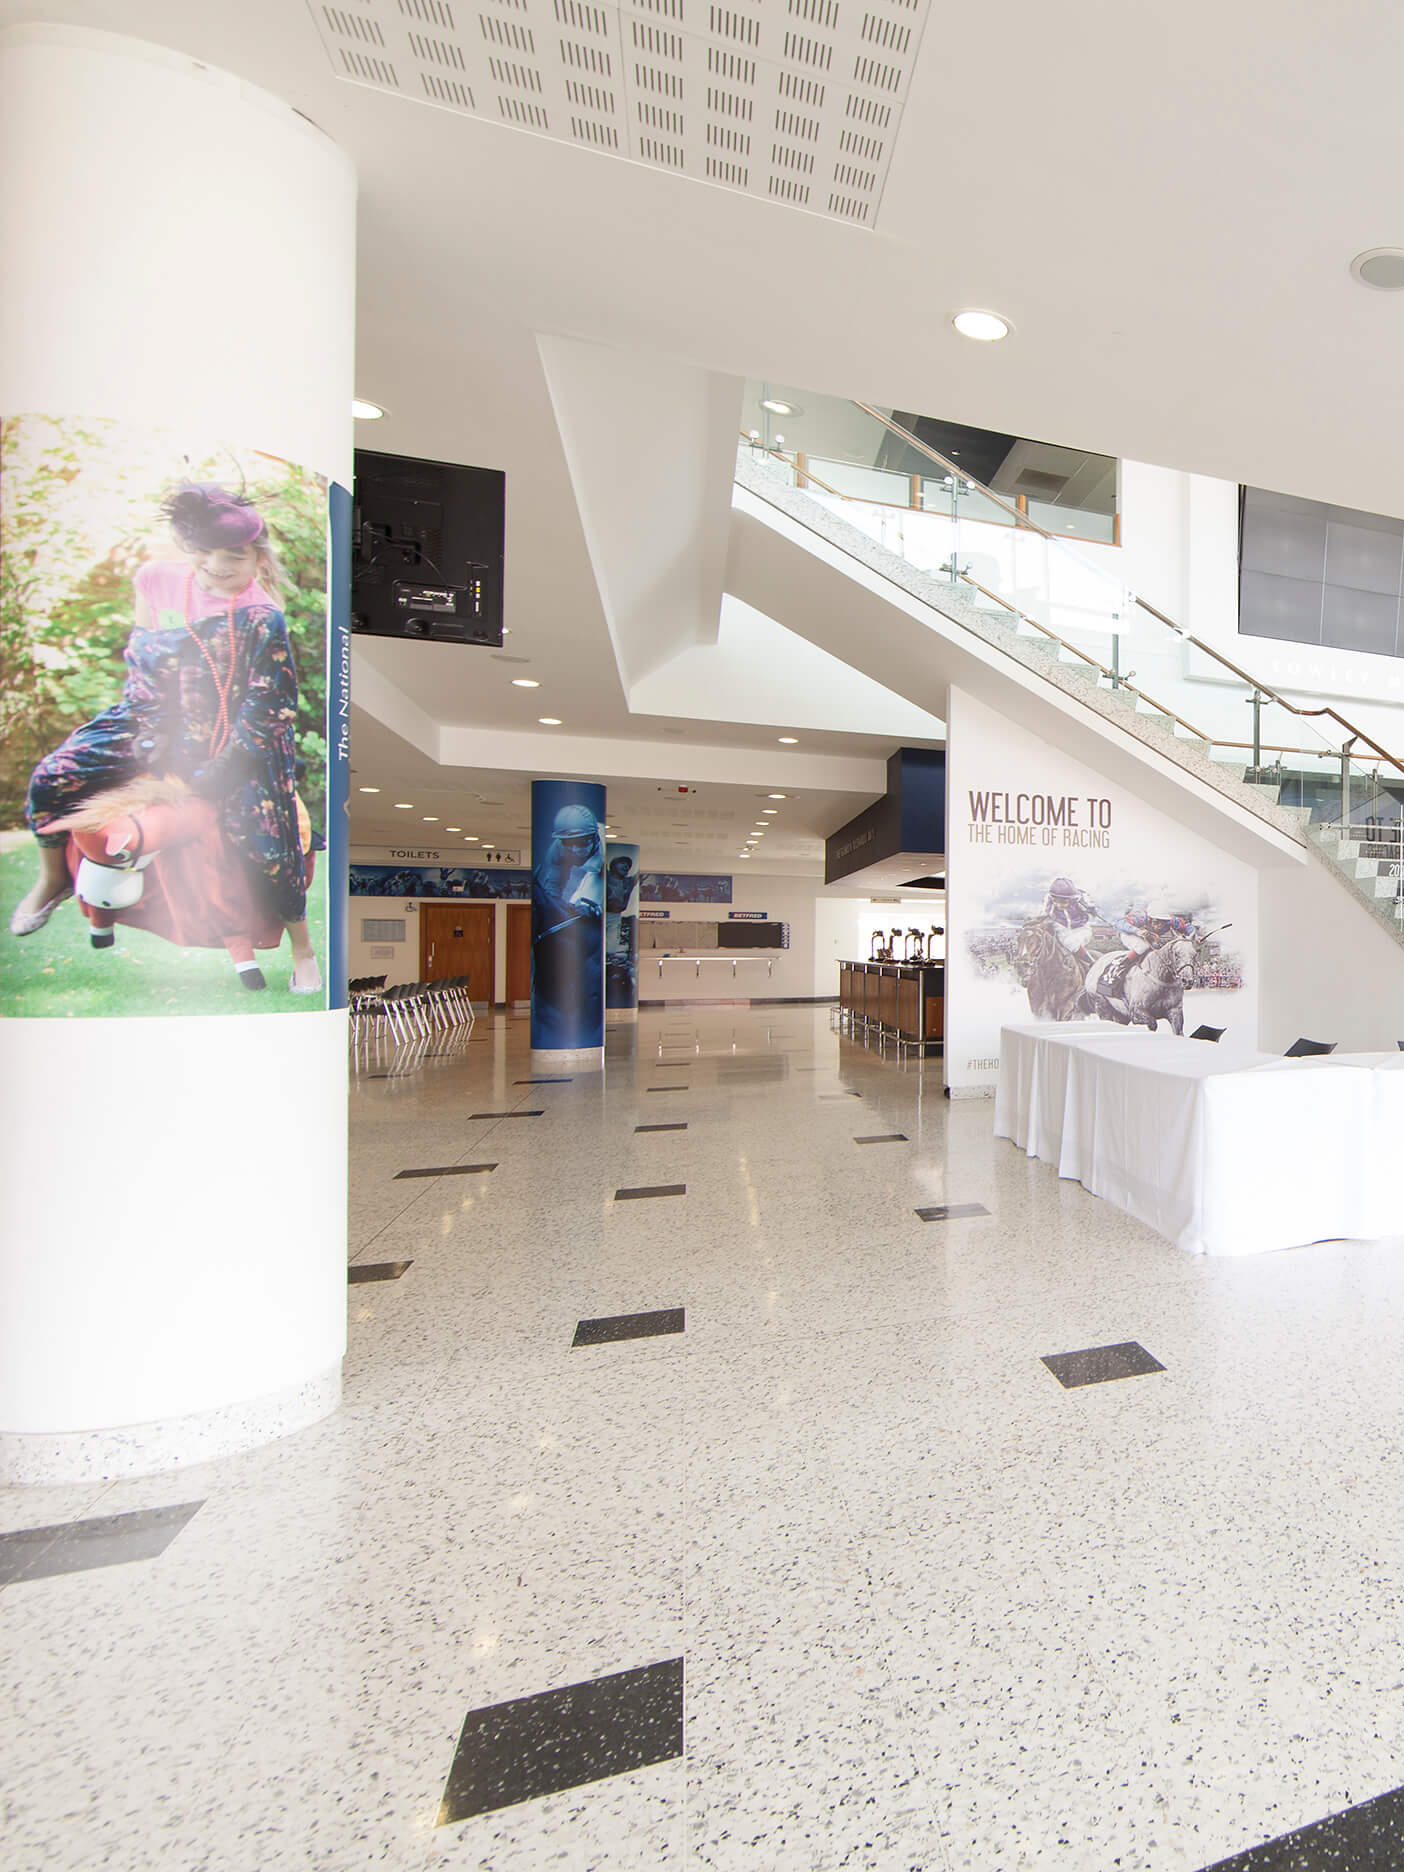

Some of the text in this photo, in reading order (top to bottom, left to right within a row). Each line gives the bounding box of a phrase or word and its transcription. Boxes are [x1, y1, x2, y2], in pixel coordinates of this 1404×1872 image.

[338, 626, 350, 761] The National
[967, 790, 1112, 829] WELCOME TO
[967, 823, 1110, 849] THE HOME OF RACING
[389, 850, 441, 860] TOILETS
